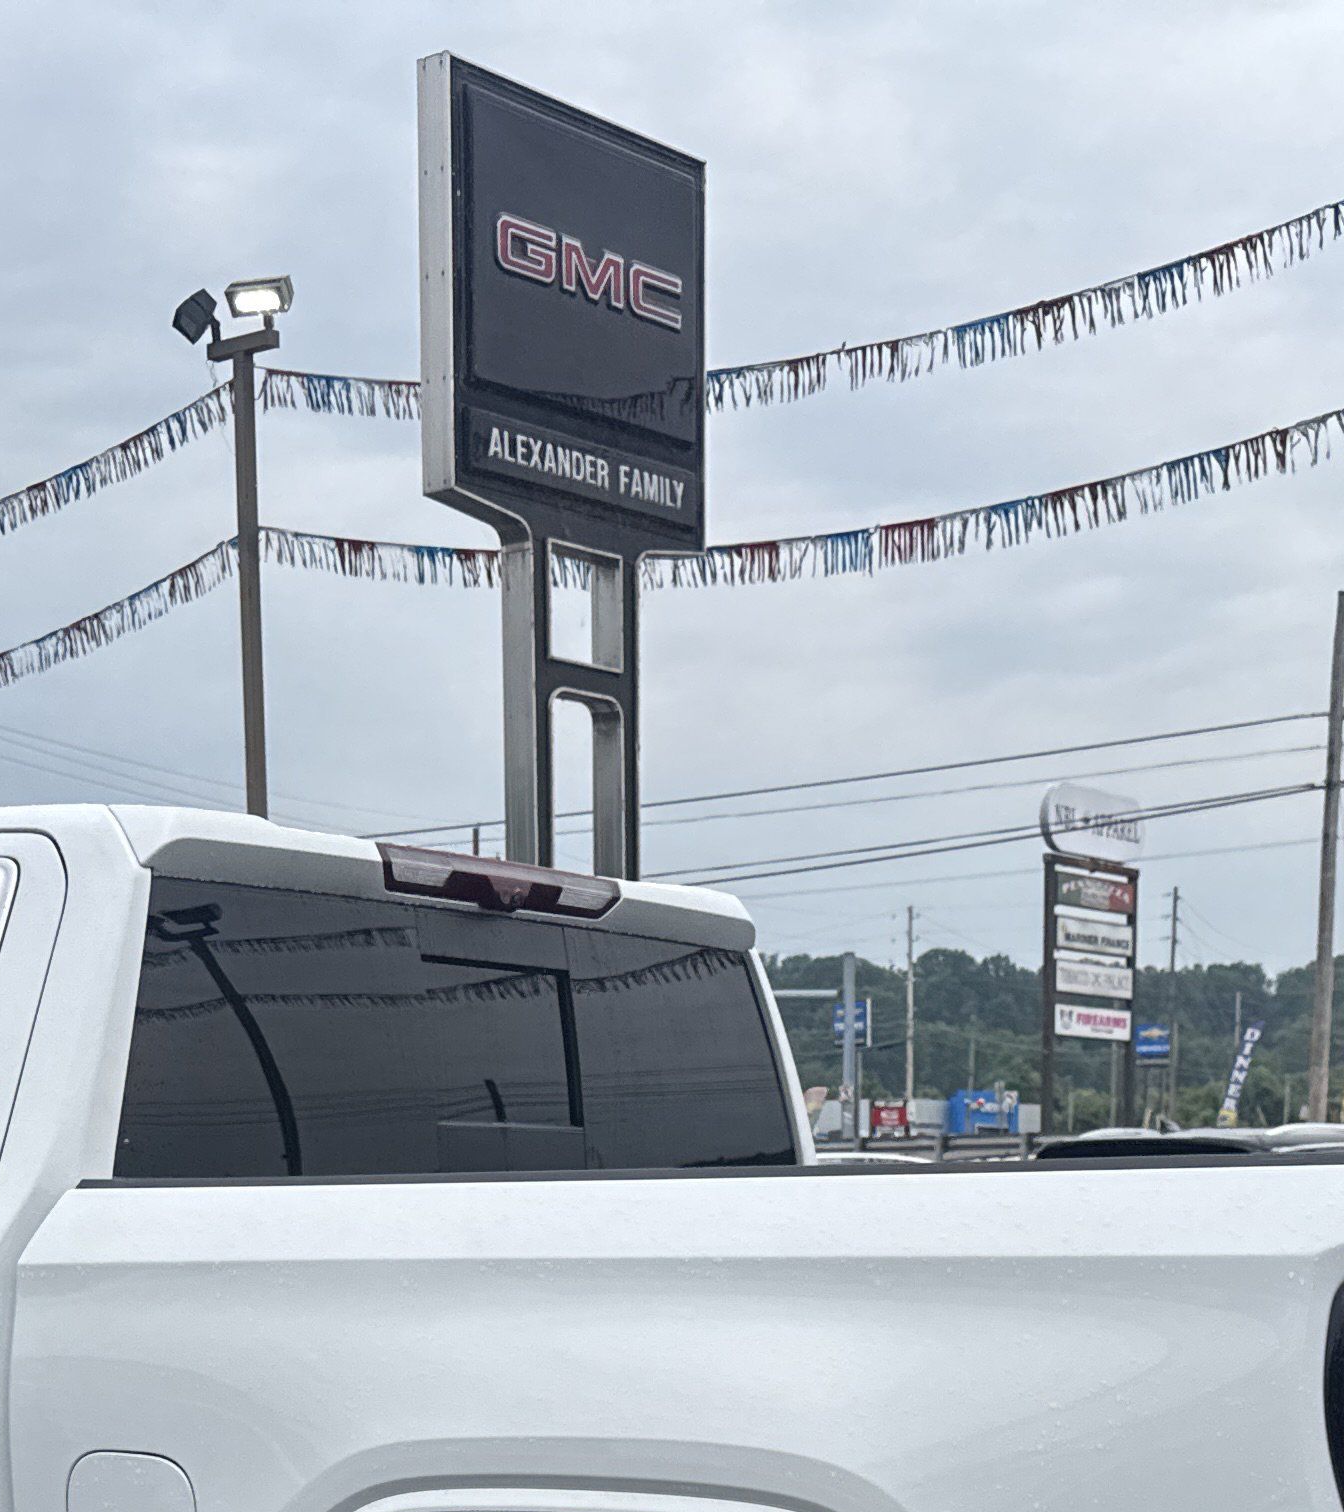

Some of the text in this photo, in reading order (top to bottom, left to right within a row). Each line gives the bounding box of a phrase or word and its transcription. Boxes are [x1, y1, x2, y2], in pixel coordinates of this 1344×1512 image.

[496, 212, 682, 330] GMC
[488, 427, 684, 510] ALEXANDER FAMILY
